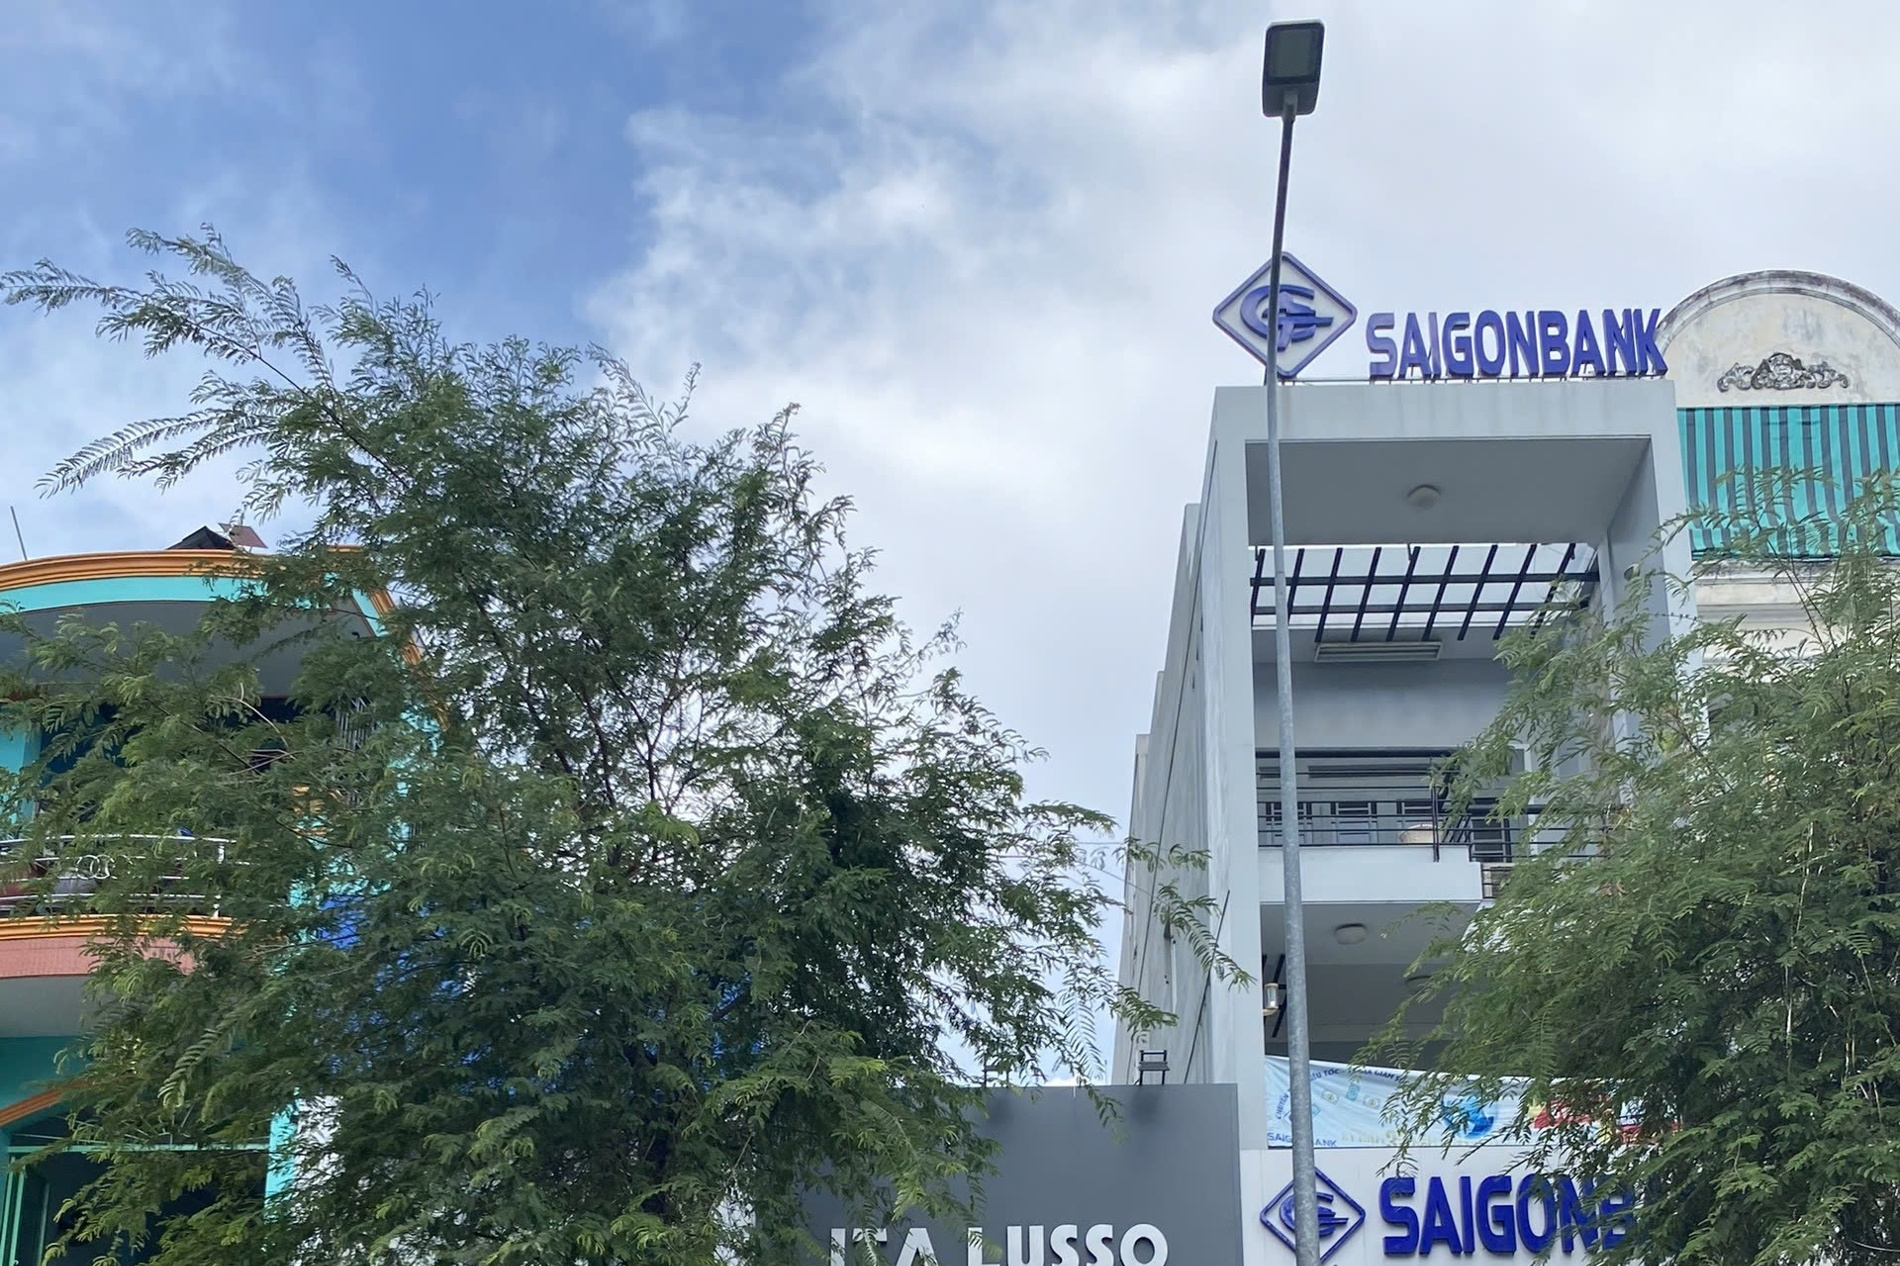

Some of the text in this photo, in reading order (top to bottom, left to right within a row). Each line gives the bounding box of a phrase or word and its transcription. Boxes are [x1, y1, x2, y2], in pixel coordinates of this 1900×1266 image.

[1365, 308, 1669, 378] SAIGONBANK
[1267, 1132, 1337, 1148] SAIGANK
[1379, 1173, 1660, 1257] SAIGONB
